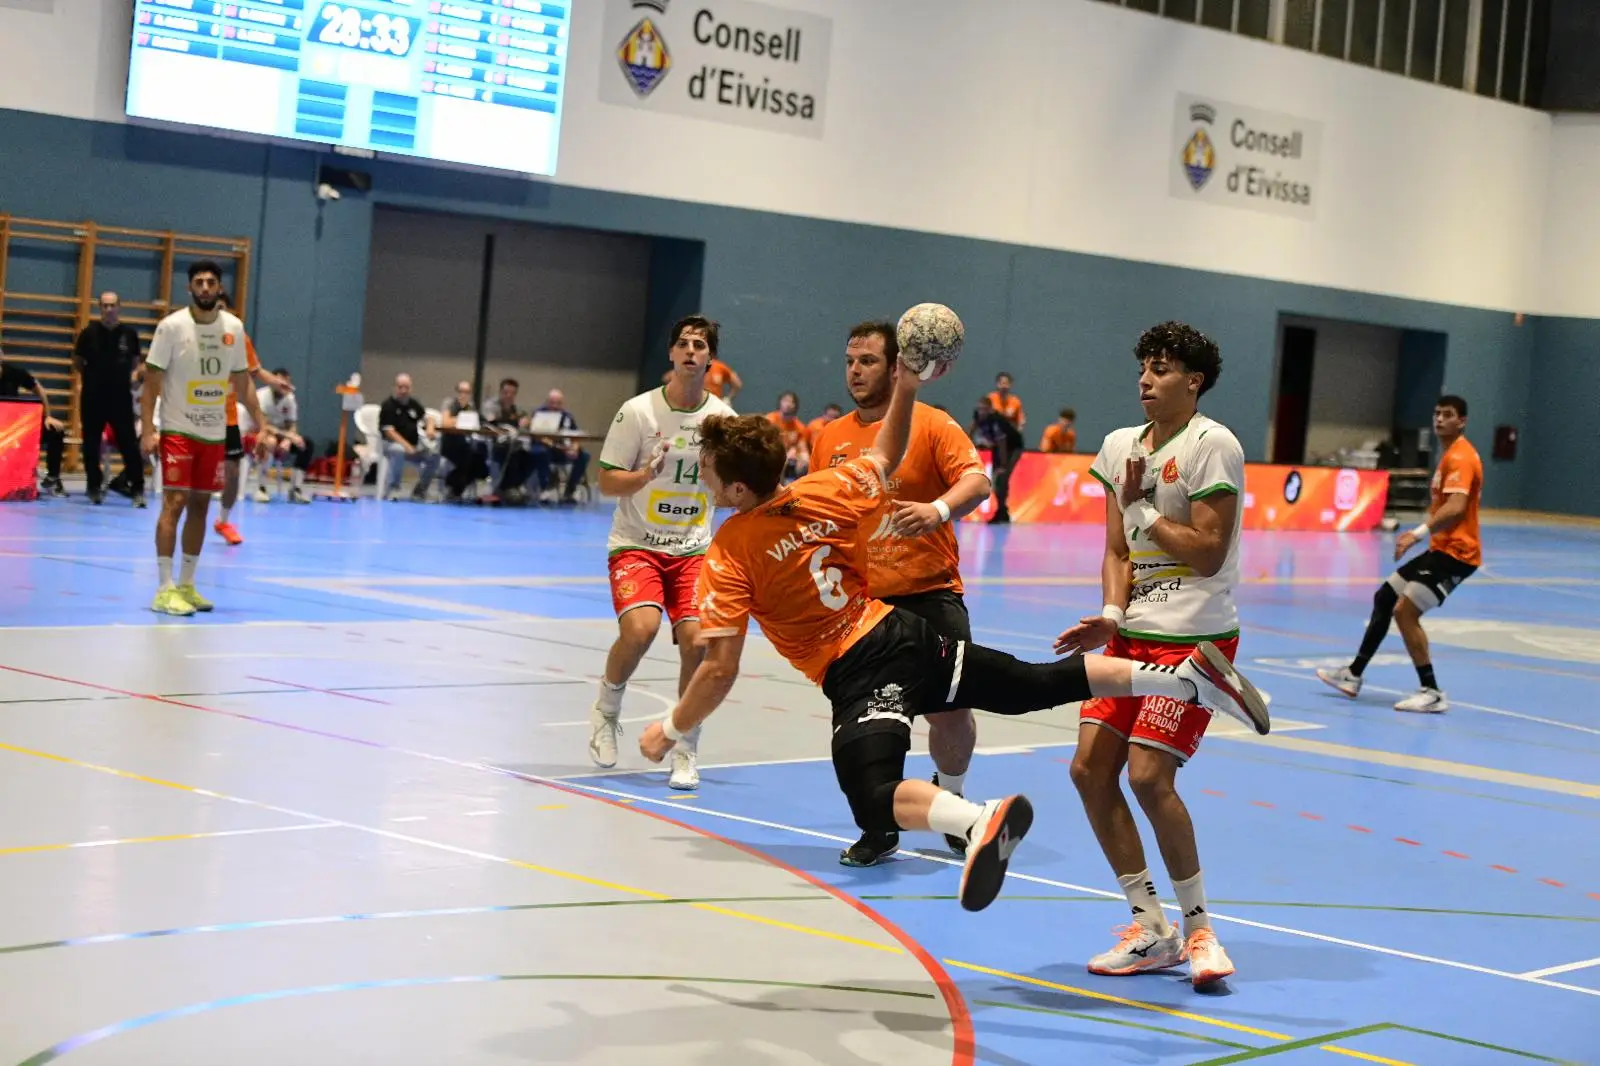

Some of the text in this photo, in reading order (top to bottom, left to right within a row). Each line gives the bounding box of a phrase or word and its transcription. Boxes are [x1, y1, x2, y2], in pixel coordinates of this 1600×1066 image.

[693, 9, 801, 62] Consell
[688, 66, 815, 119] d'Eivissa
[1230, 118, 1302, 159] Consell
[1226, 164, 1311, 205] d'Eivissa
[200, 357, 221, 375] 10
[673, 458, 699, 485] 14
[767, 519, 840, 562] VALERA
[809, 545, 849, 611] 6
[1142, 695, 1184, 722] SABOR
[1147, 713, 1179, 732] VERDAD
